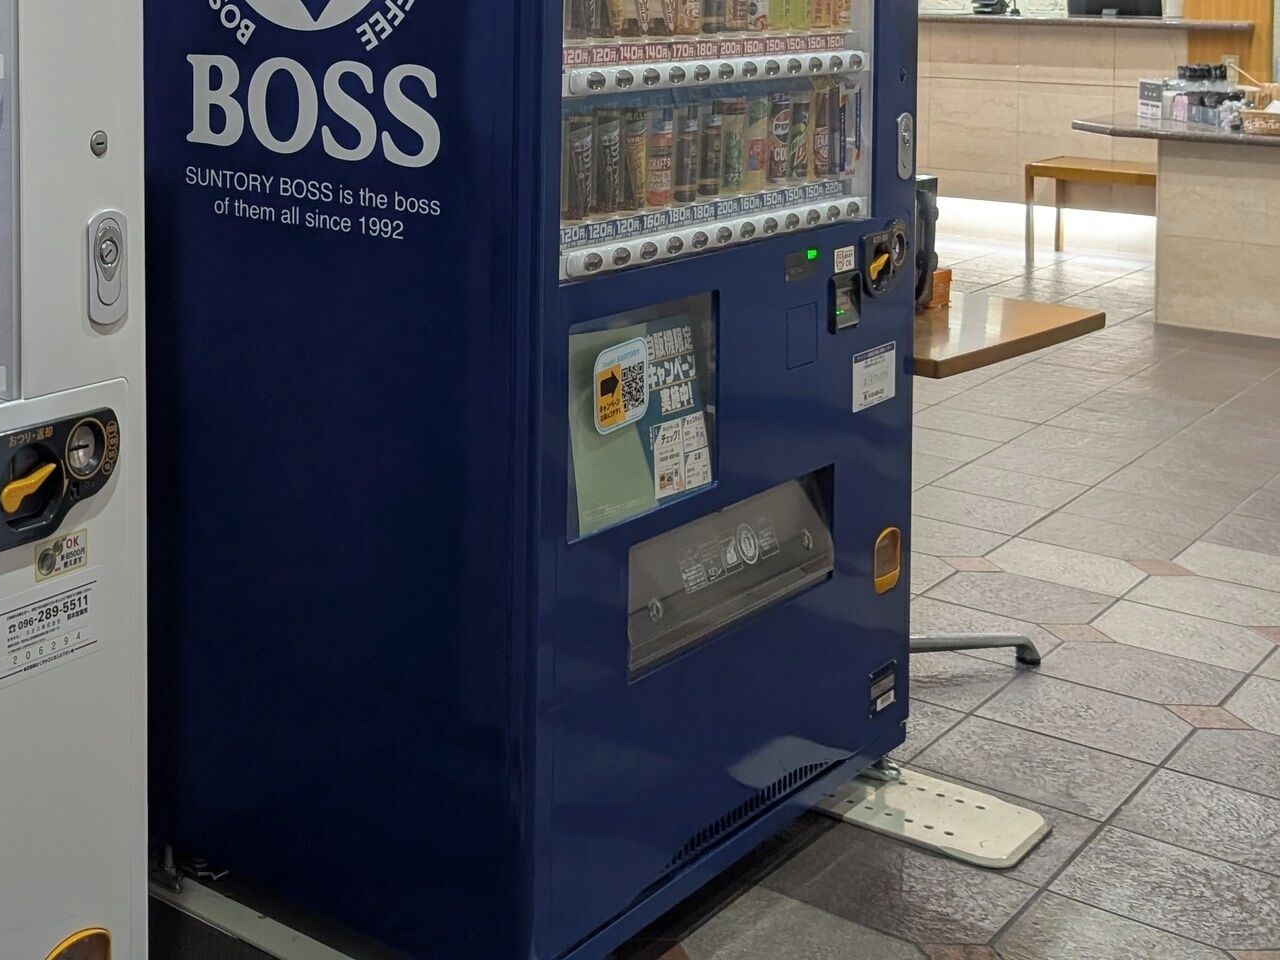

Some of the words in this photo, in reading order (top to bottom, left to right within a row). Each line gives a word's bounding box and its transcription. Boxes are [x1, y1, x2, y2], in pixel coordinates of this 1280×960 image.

[186, 53, 441, 168] BOSS
[185, 166, 274, 198] SUNTORY
[280, 174, 333, 204] BOSS
[339, 180, 353, 205] is
[359, 186, 388, 210] the
[394, 190, 441, 216] boss
[214, 197, 230, 216] of
[234, 199, 274, 222] them
[281, 205, 300, 225] all
[304, 210, 352, 232] since
[358, 215, 405, 240] 1992
[647, 325, 694, 360] 自販機限定
[647, 356, 696, 388] キャンペーン
[660, 381, 694, 414] 実施中!
[65, 536, 79, 549] OK
[18, 594, 88, 630] 096-289-5511
